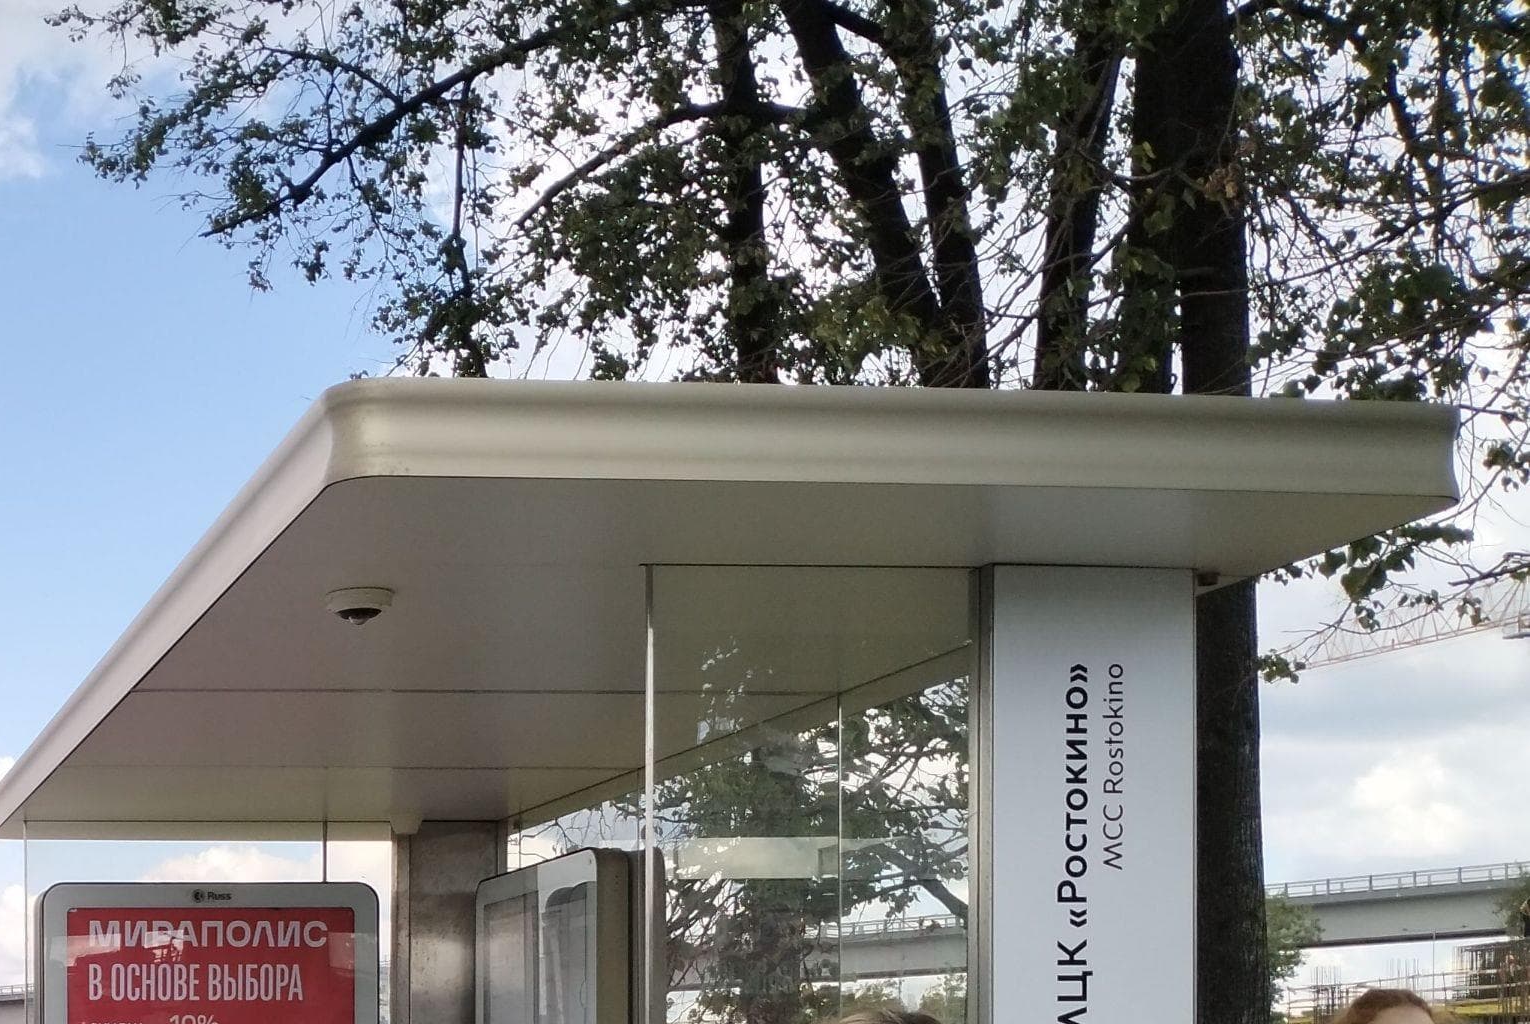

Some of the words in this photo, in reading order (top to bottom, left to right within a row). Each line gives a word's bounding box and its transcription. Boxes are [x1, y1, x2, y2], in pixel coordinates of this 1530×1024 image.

[1103, 663, 1124, 795] Rostokino
[1057, 663, 1091, 928] «Ростокино»
[1103, 803, 1124, 871] MCC
[207, 891, 232, 901] Russ
[89, 920, 328, 948] МИРАПОЛИС
[89, 963, 103, 1001] В
[111, 963, 200, 1001] ОСНОВЕ
[208, 963, 303, 1001] ВЫБОРА
